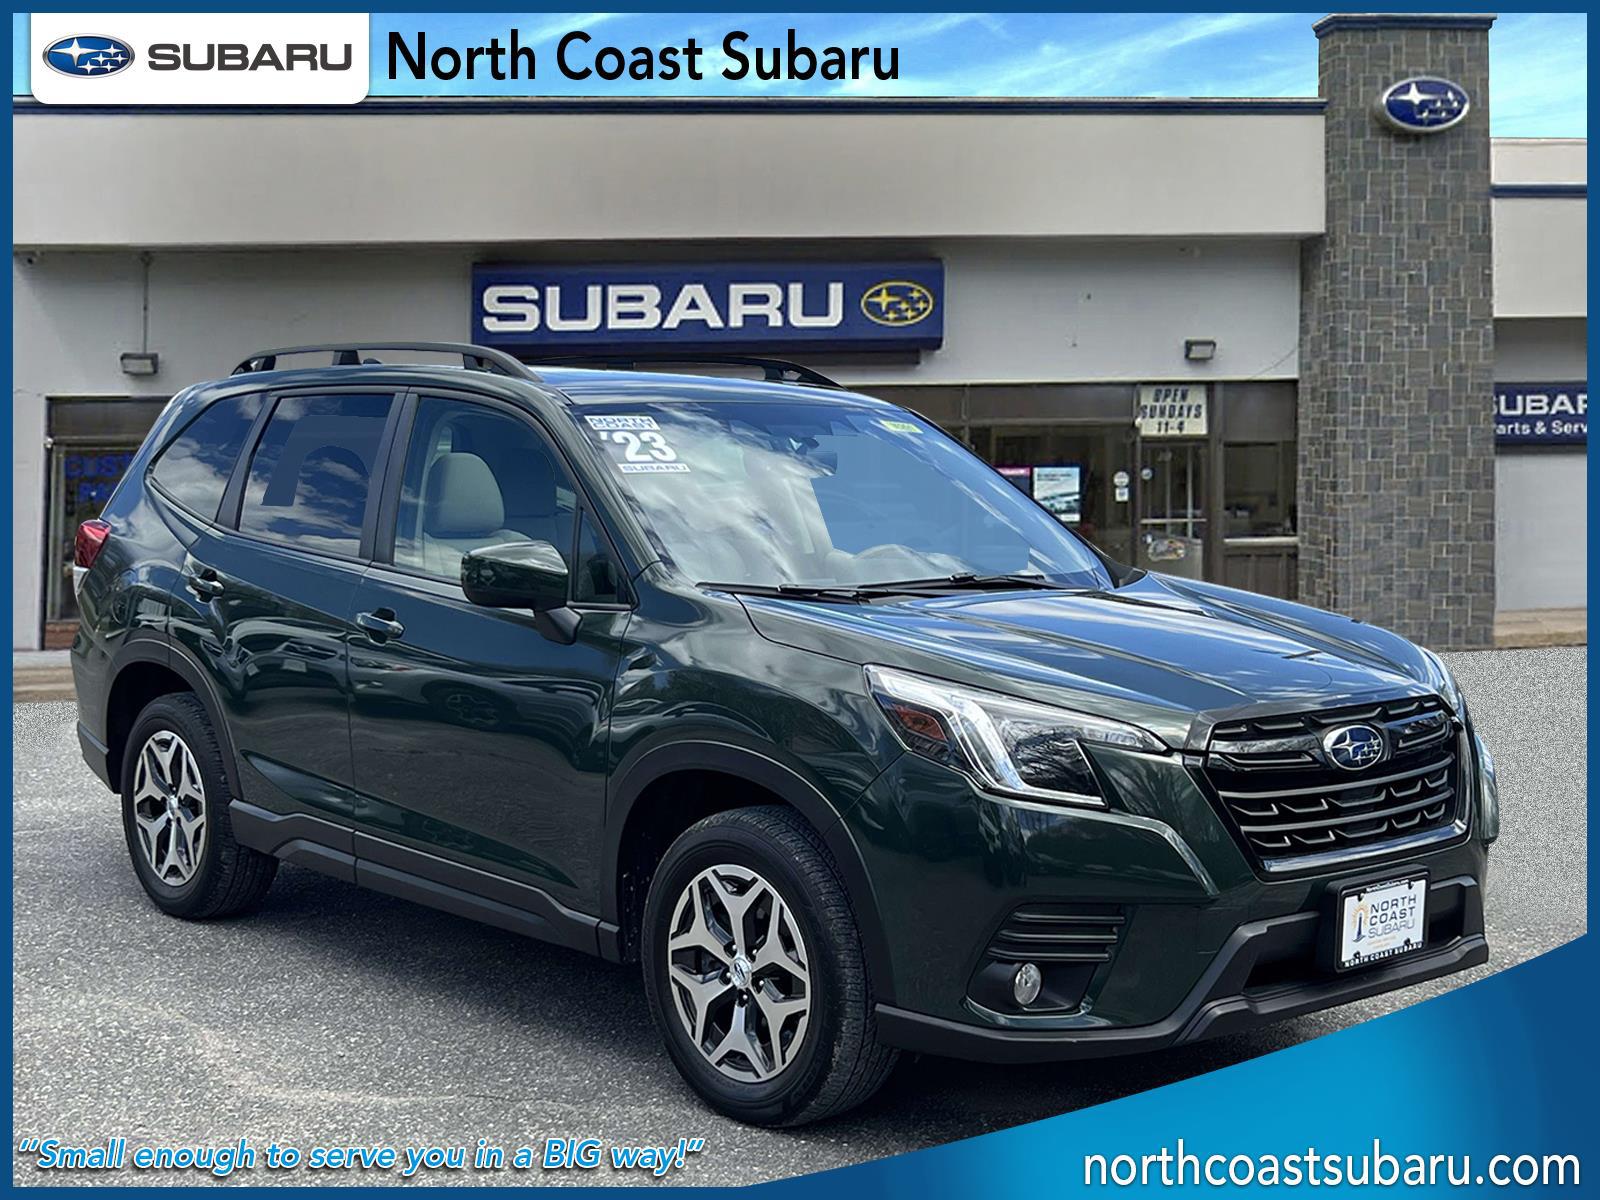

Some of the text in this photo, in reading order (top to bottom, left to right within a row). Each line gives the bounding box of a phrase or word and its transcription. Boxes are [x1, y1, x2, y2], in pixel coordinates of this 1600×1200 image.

[483, 282, 843, 332] SUBARU
[1153, 388, 1189, 402] OPEN
[1140, 404, 1203, 419] SUNDAYS
[1493, 394, 1587, 415] UBA
[588, 416, 653, 424] NORTH
[1157, 421, 1185, 433] 11-4
[1534, 420, 1546, 435] &
[600, 431, 677, 463] '23
[622, 464, 687, 472] SUBARU
[1370, 894, 1417, 914] NORTH
[1369, 906, 1416, 927] COAST
[1368, 919, 1415, 939] SUBARU
[1344, 956, 1369, 968] NORTH
